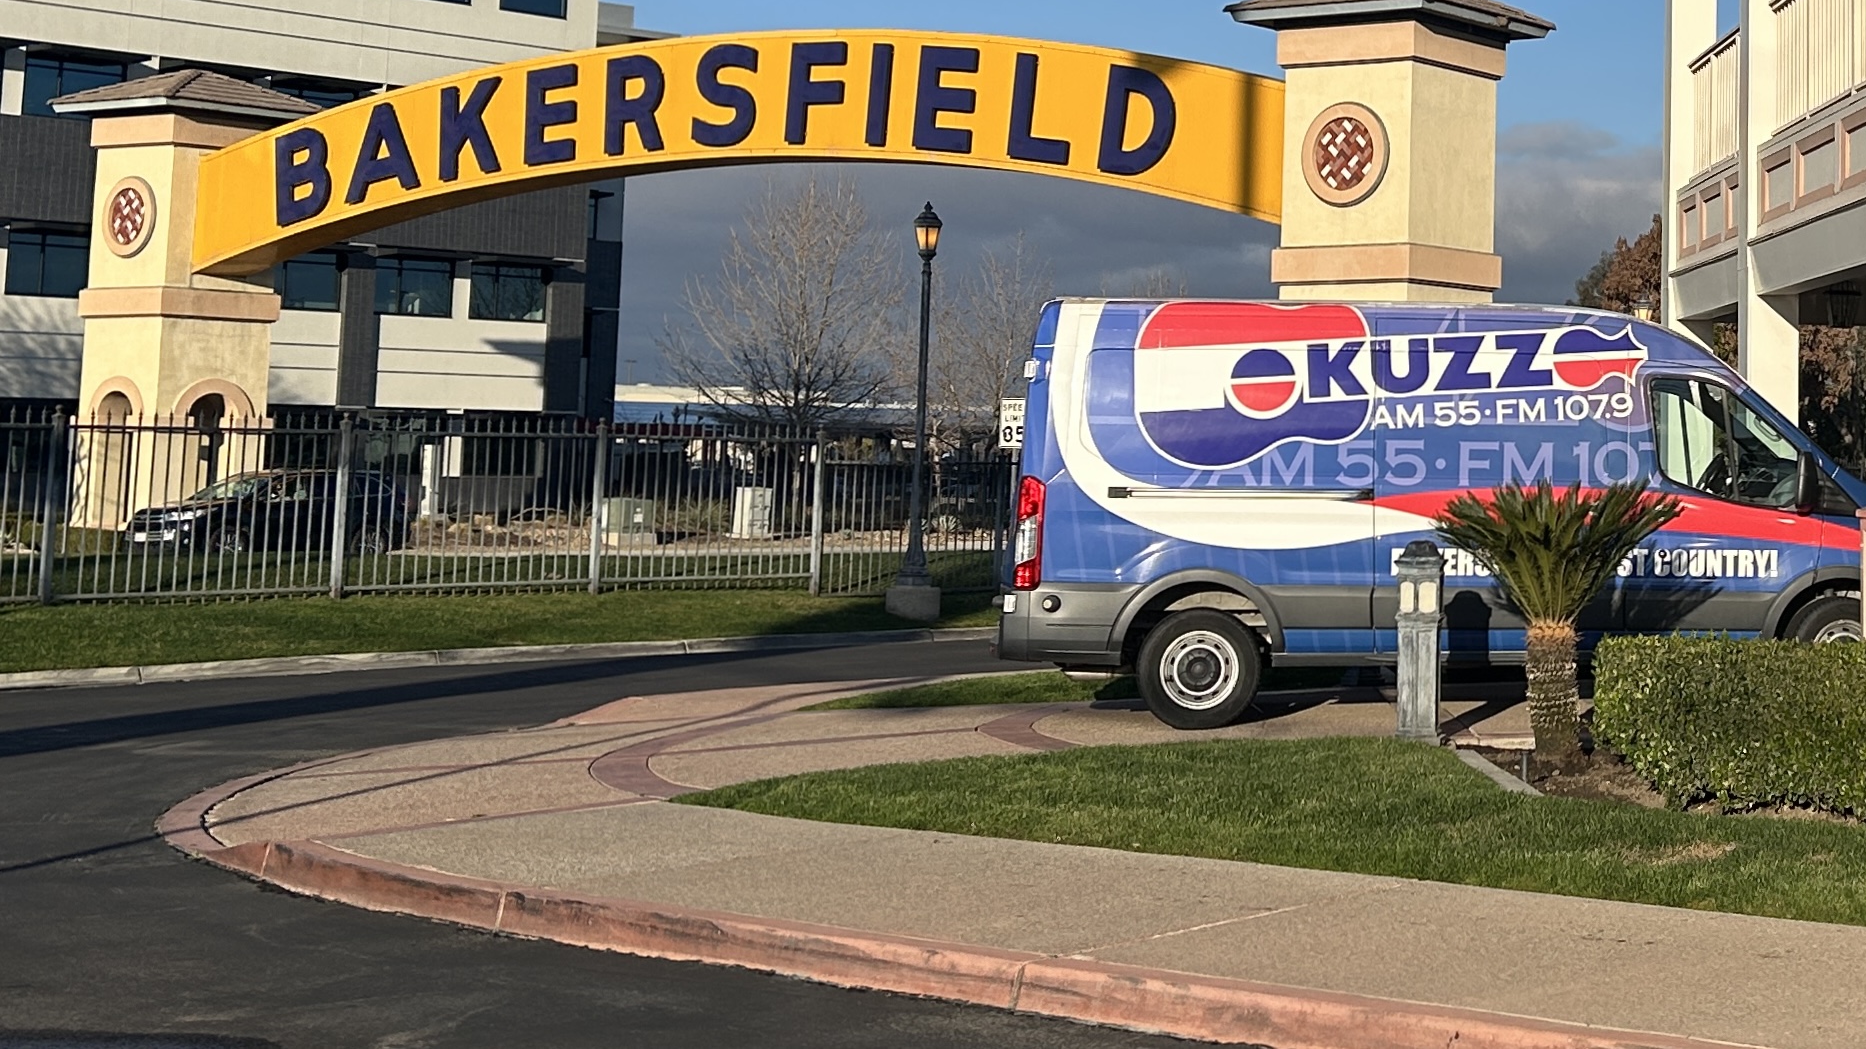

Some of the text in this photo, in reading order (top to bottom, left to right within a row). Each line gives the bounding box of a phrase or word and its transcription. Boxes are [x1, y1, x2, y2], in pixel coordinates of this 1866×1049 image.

[274, 41, 1178, 228] BAKERSFIELD
[1306, 331, 1554, 399] KUZZ
[1003, 403, 1024, 412] SPEE
[1371, 403, 1425, 430] AM
[1554, 392, 1634, 421] 107.9
[1654, 549, 1779, 578] COUNTRY!
